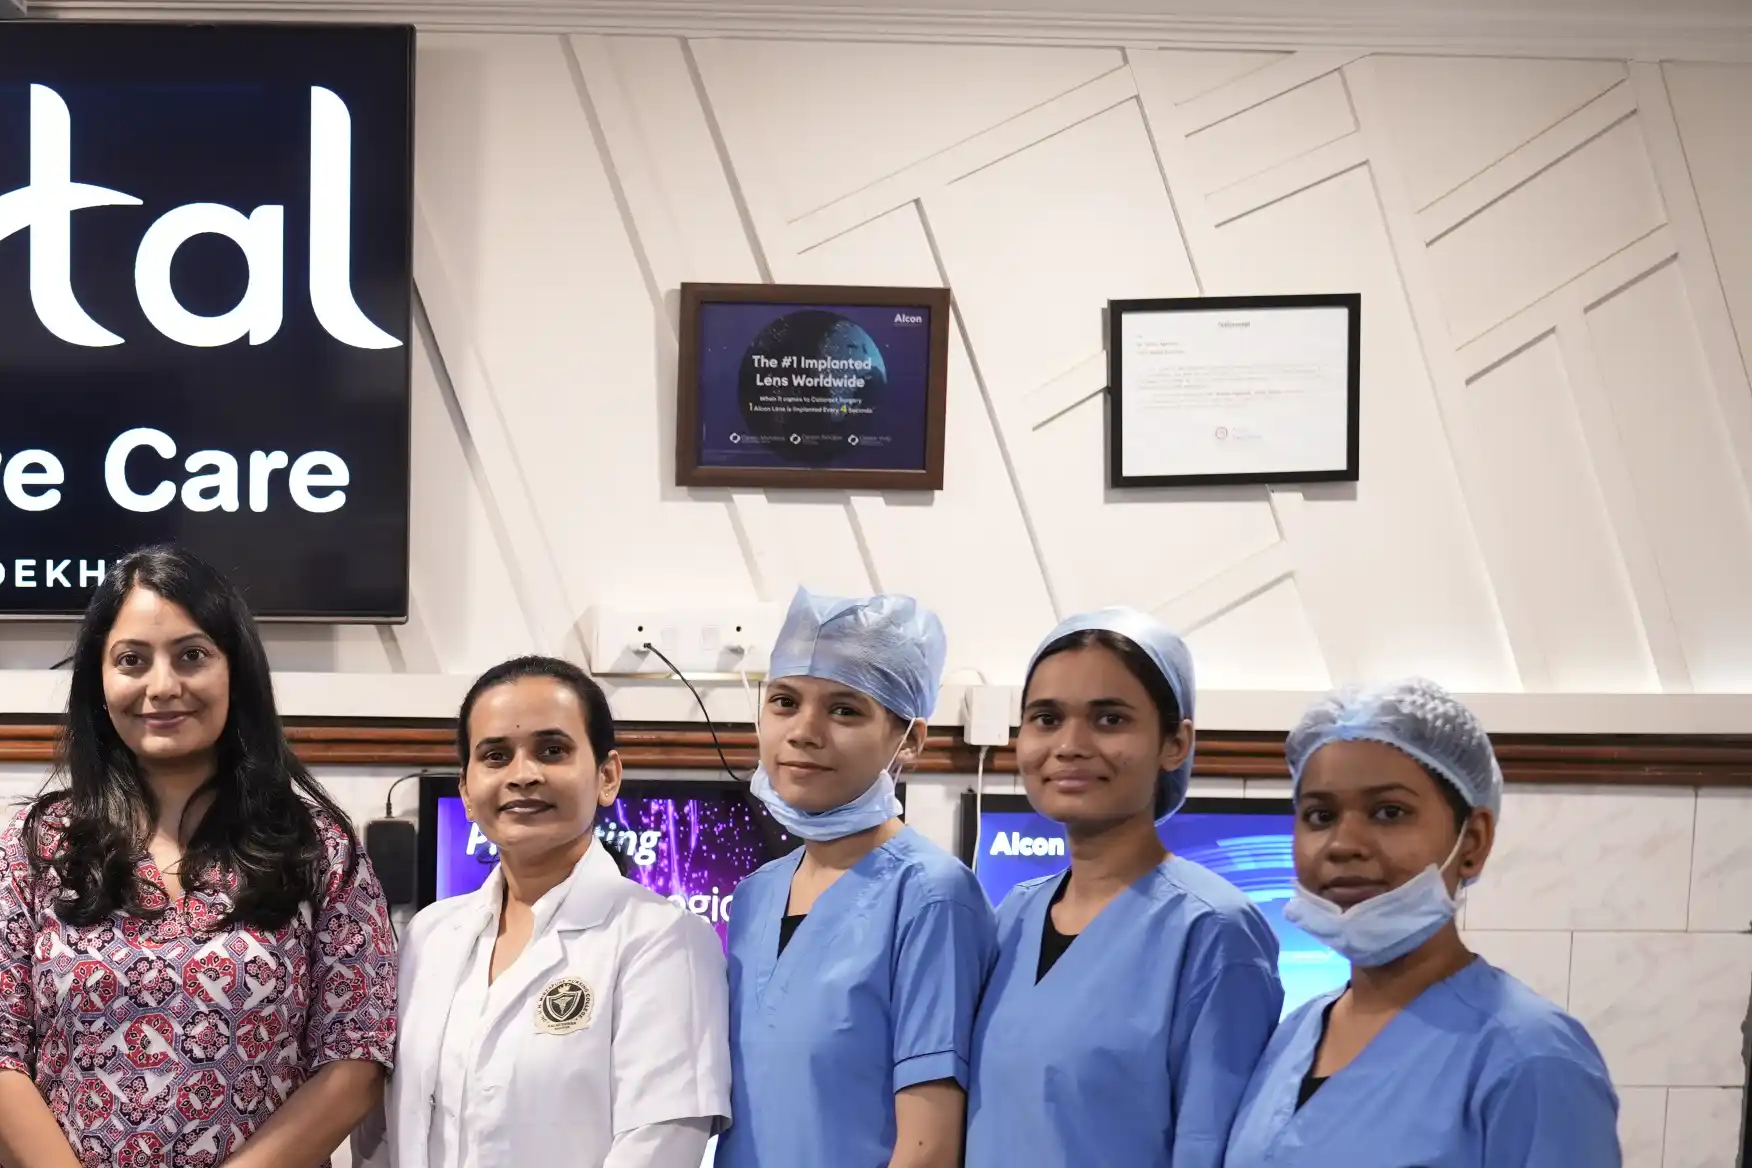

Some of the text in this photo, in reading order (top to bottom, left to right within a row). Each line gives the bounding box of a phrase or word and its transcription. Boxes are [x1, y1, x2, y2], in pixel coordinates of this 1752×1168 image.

[894, 313, 923, 324] Alcon
[752, 354, 872, 372] The #1 Implanted
[755, 373, 866, 388] Lens Worldwide
[748, 402, 753, 412] 1
[841, 404, 847, 414] 4
[104, 427, 350, 513] Care
[990, 831, 1065, 857] Alcon
